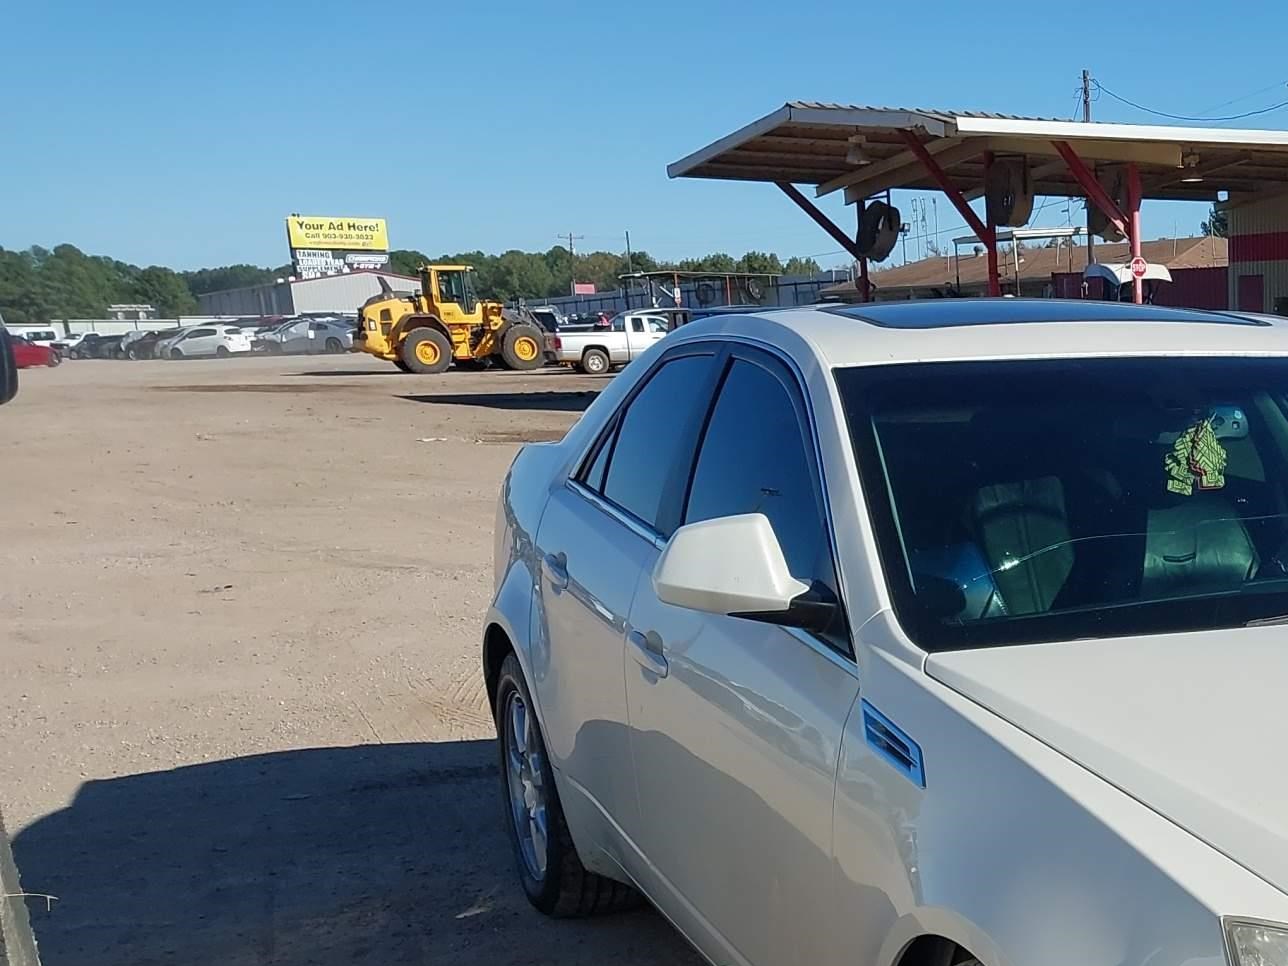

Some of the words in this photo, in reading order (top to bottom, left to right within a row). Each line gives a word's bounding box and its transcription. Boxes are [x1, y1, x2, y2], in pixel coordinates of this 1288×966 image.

[297, 220, 325, 231] Your
[328, 221, 345, 231] Ad
[347, 222, 379, 232] Here!
[304, 232, 321, 240] Call
[298, 251, 331, 259] TANNING
[1132, 263, 1145, 272] STOP
